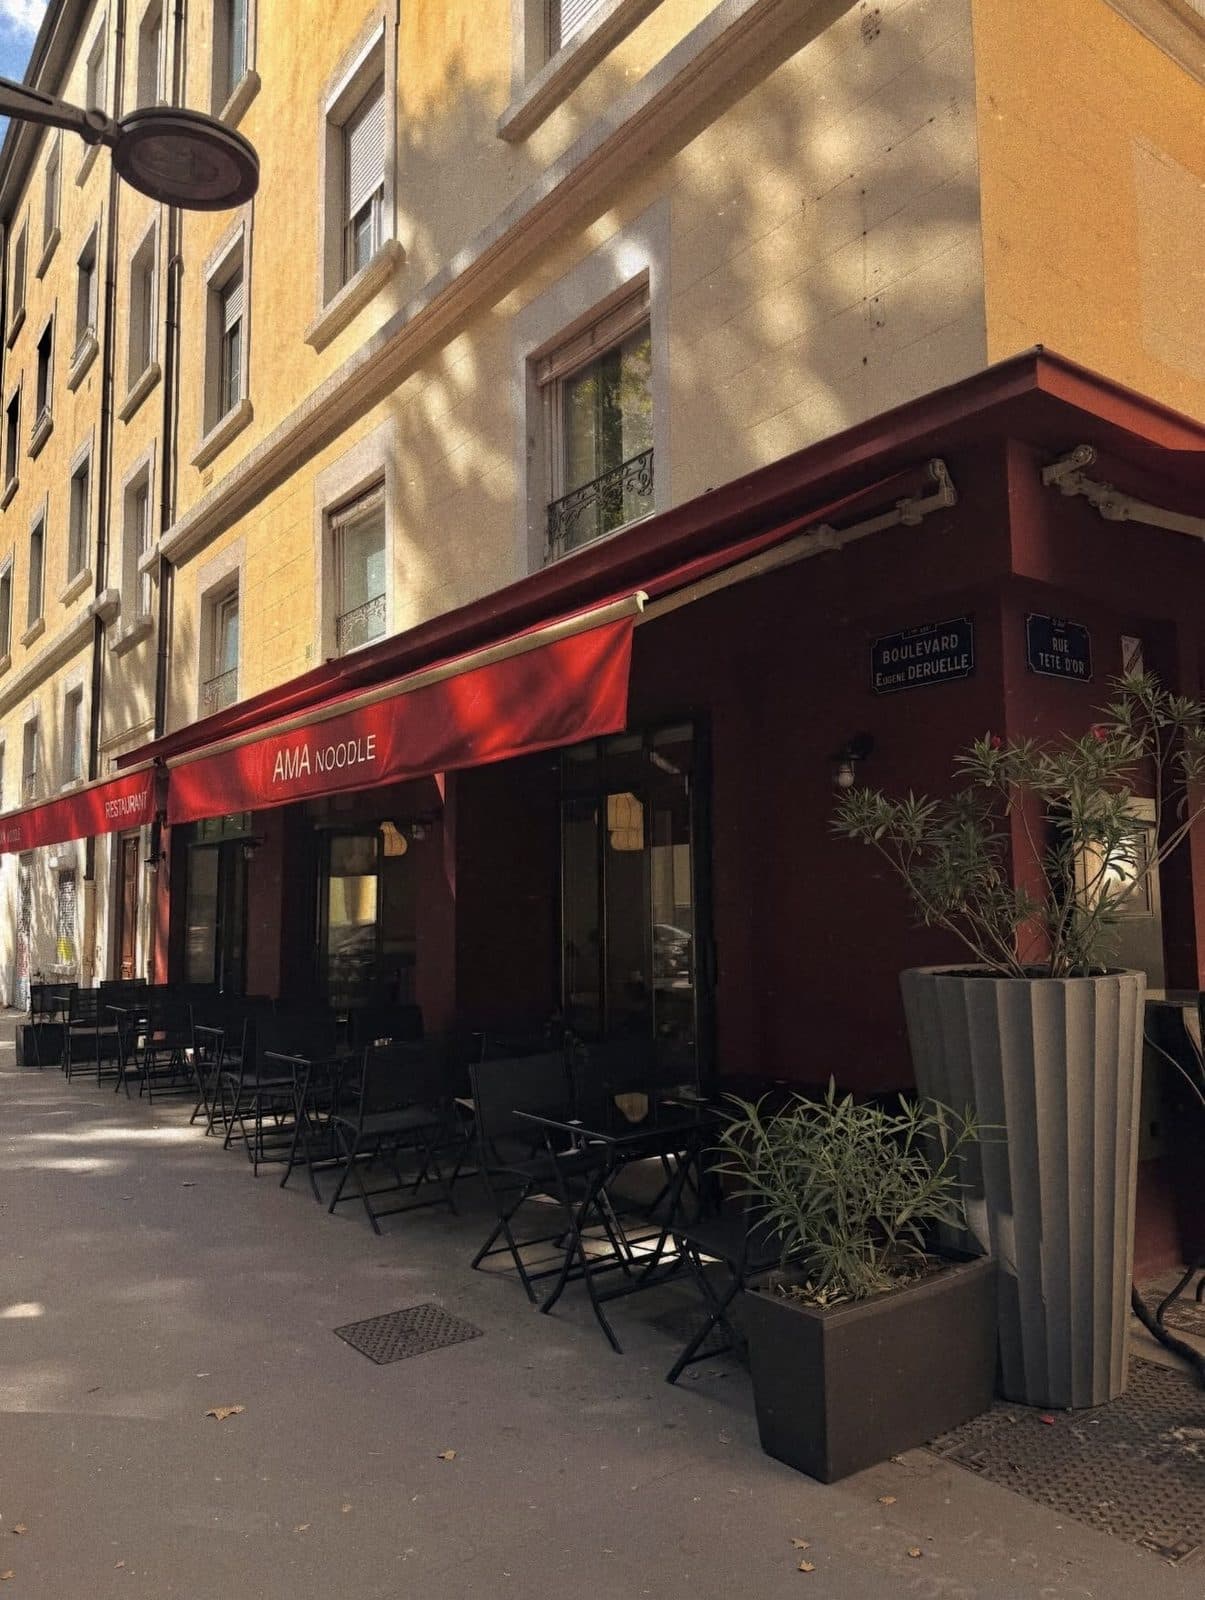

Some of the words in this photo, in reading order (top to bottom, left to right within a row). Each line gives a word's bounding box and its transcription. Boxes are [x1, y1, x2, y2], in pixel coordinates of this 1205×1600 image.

[883, 634, 959, 664] BOULEVARD
[1052, 637, 1069, 653] RUE
[908, 654, 969, 680] DERUELLE
[1065, 657, 1085, 675] D'OR
[273, 743, 311, 783] AMA
[315, 734, 376, 773] NOODLE
[105, 791, 148, 819] RESTAURANT
